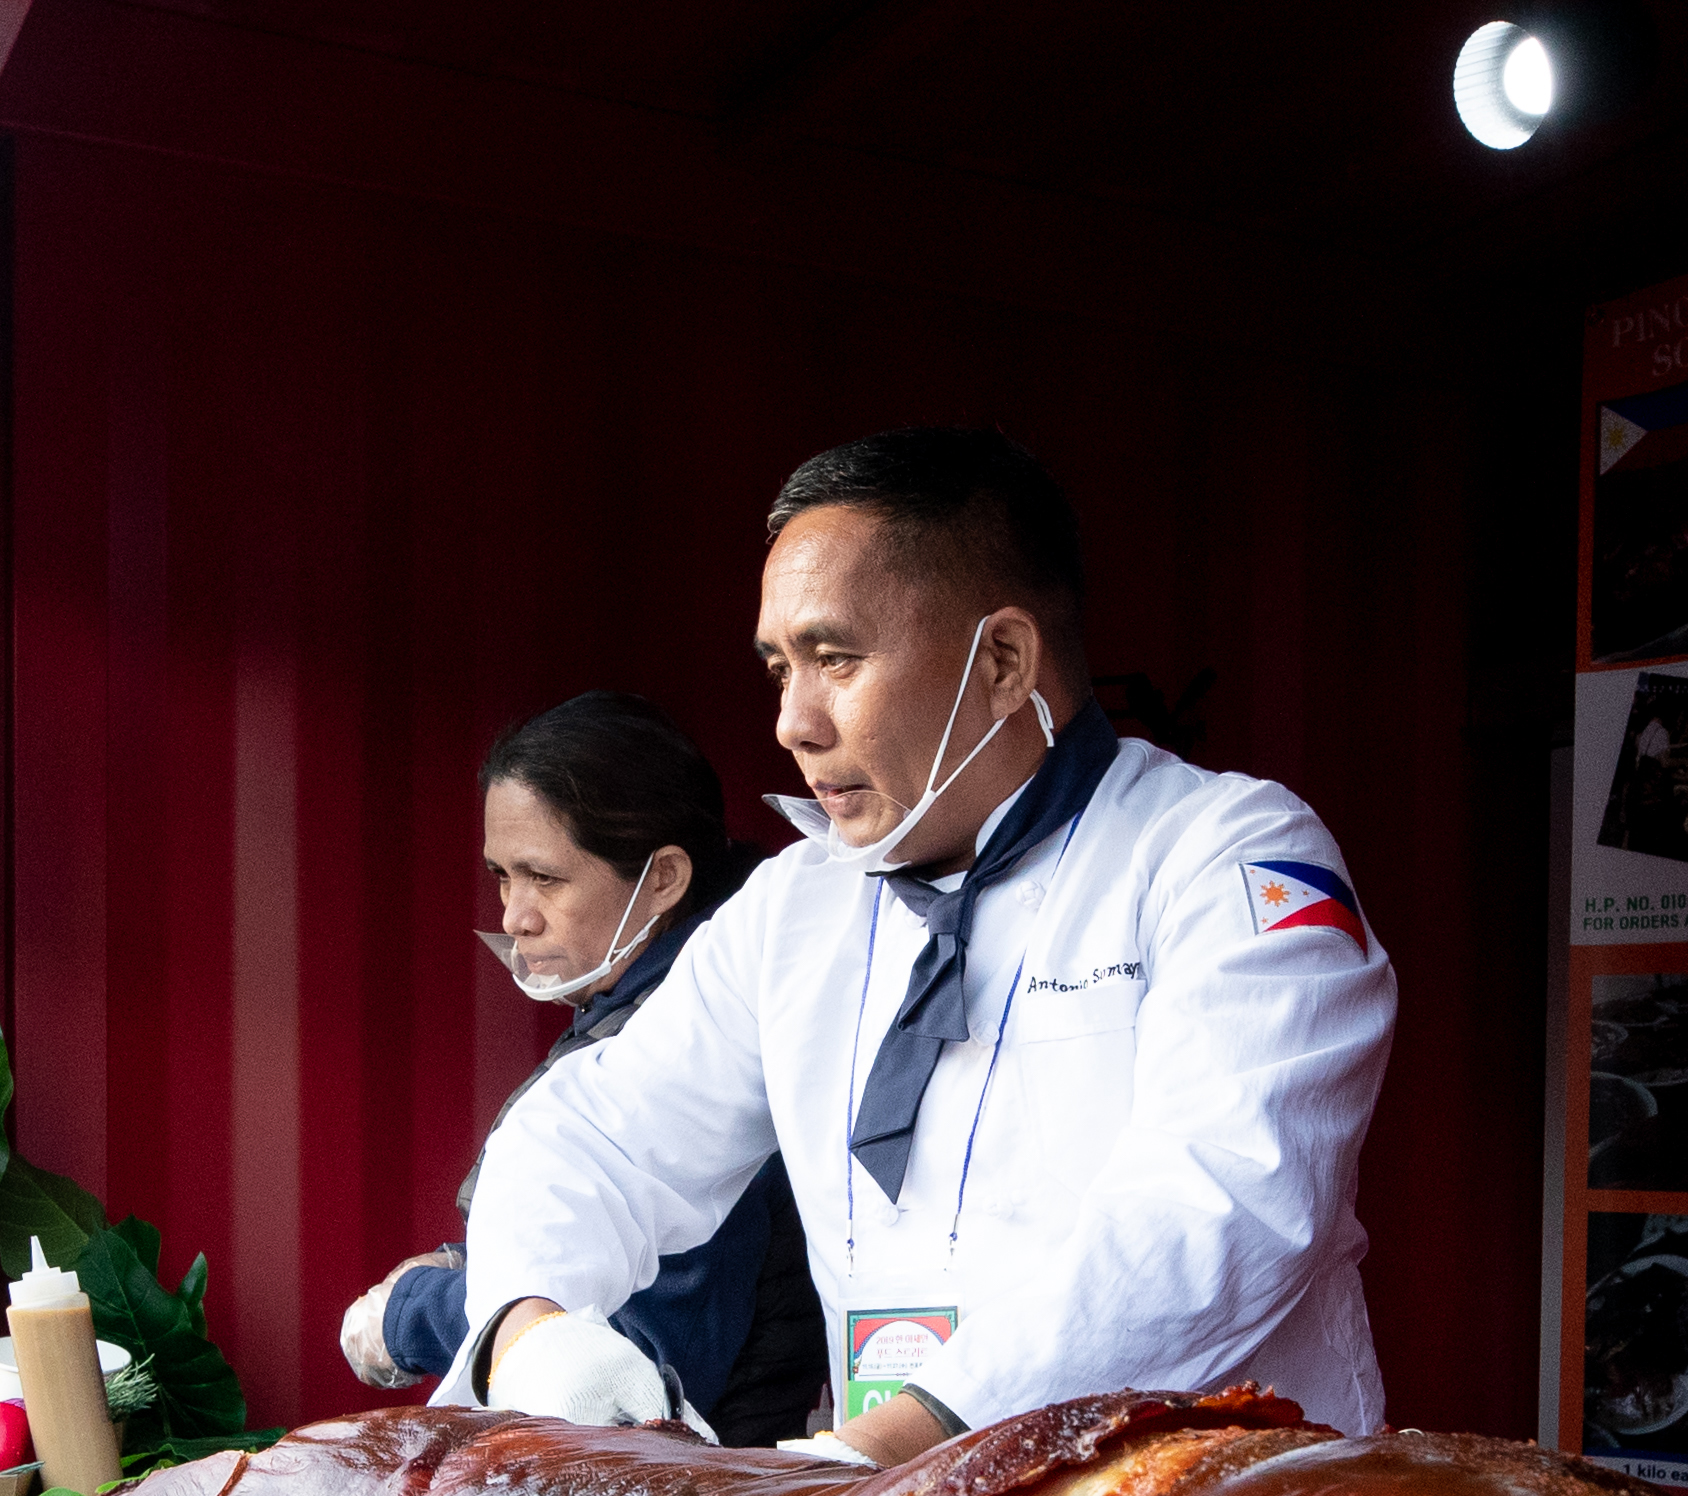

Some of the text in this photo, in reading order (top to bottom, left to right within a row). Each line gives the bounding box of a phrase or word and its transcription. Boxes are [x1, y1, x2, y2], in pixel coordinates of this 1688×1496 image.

[1585, 898, 1619, 913] H.P.
[1627, 896, 1655, 911] NO.
[1583, 916, 1614, 931] FOR
[1619, 914, 1679, 931] ORDERS
[1027, 976, 1088, 993] Antonio
[1637, 1464, 1666, 1480] kilo
